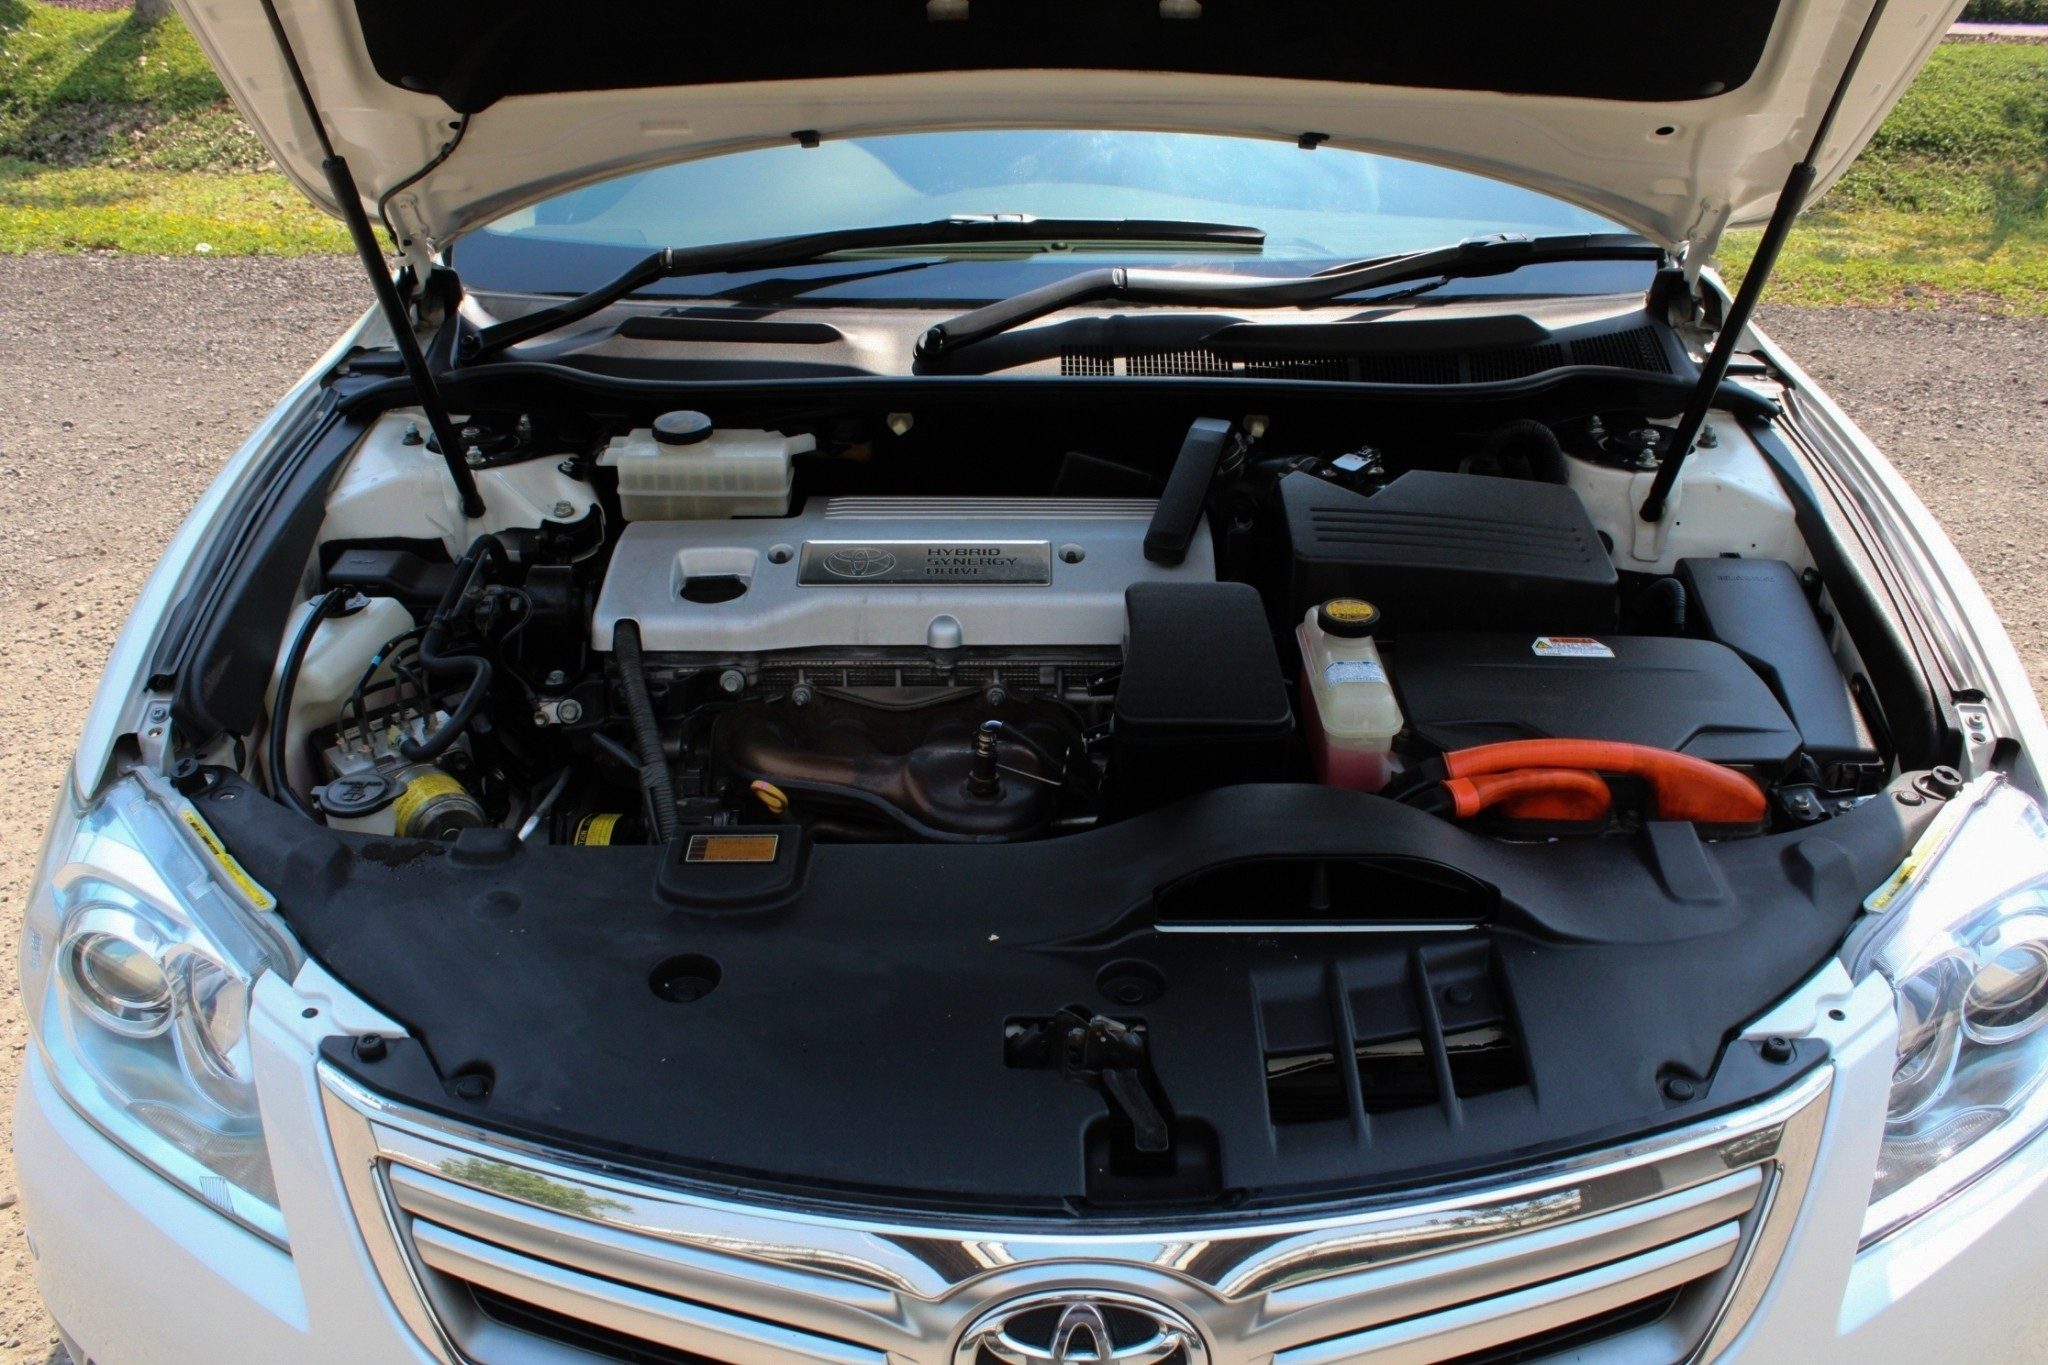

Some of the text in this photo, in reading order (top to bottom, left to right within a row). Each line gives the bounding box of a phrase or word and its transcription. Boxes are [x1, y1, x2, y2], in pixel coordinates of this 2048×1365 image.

[927, 548, 1001, 556] HYBRID
[926, 557, 1018, 566] SYNERGY
[926, 567, 982, 575] DRIVE
